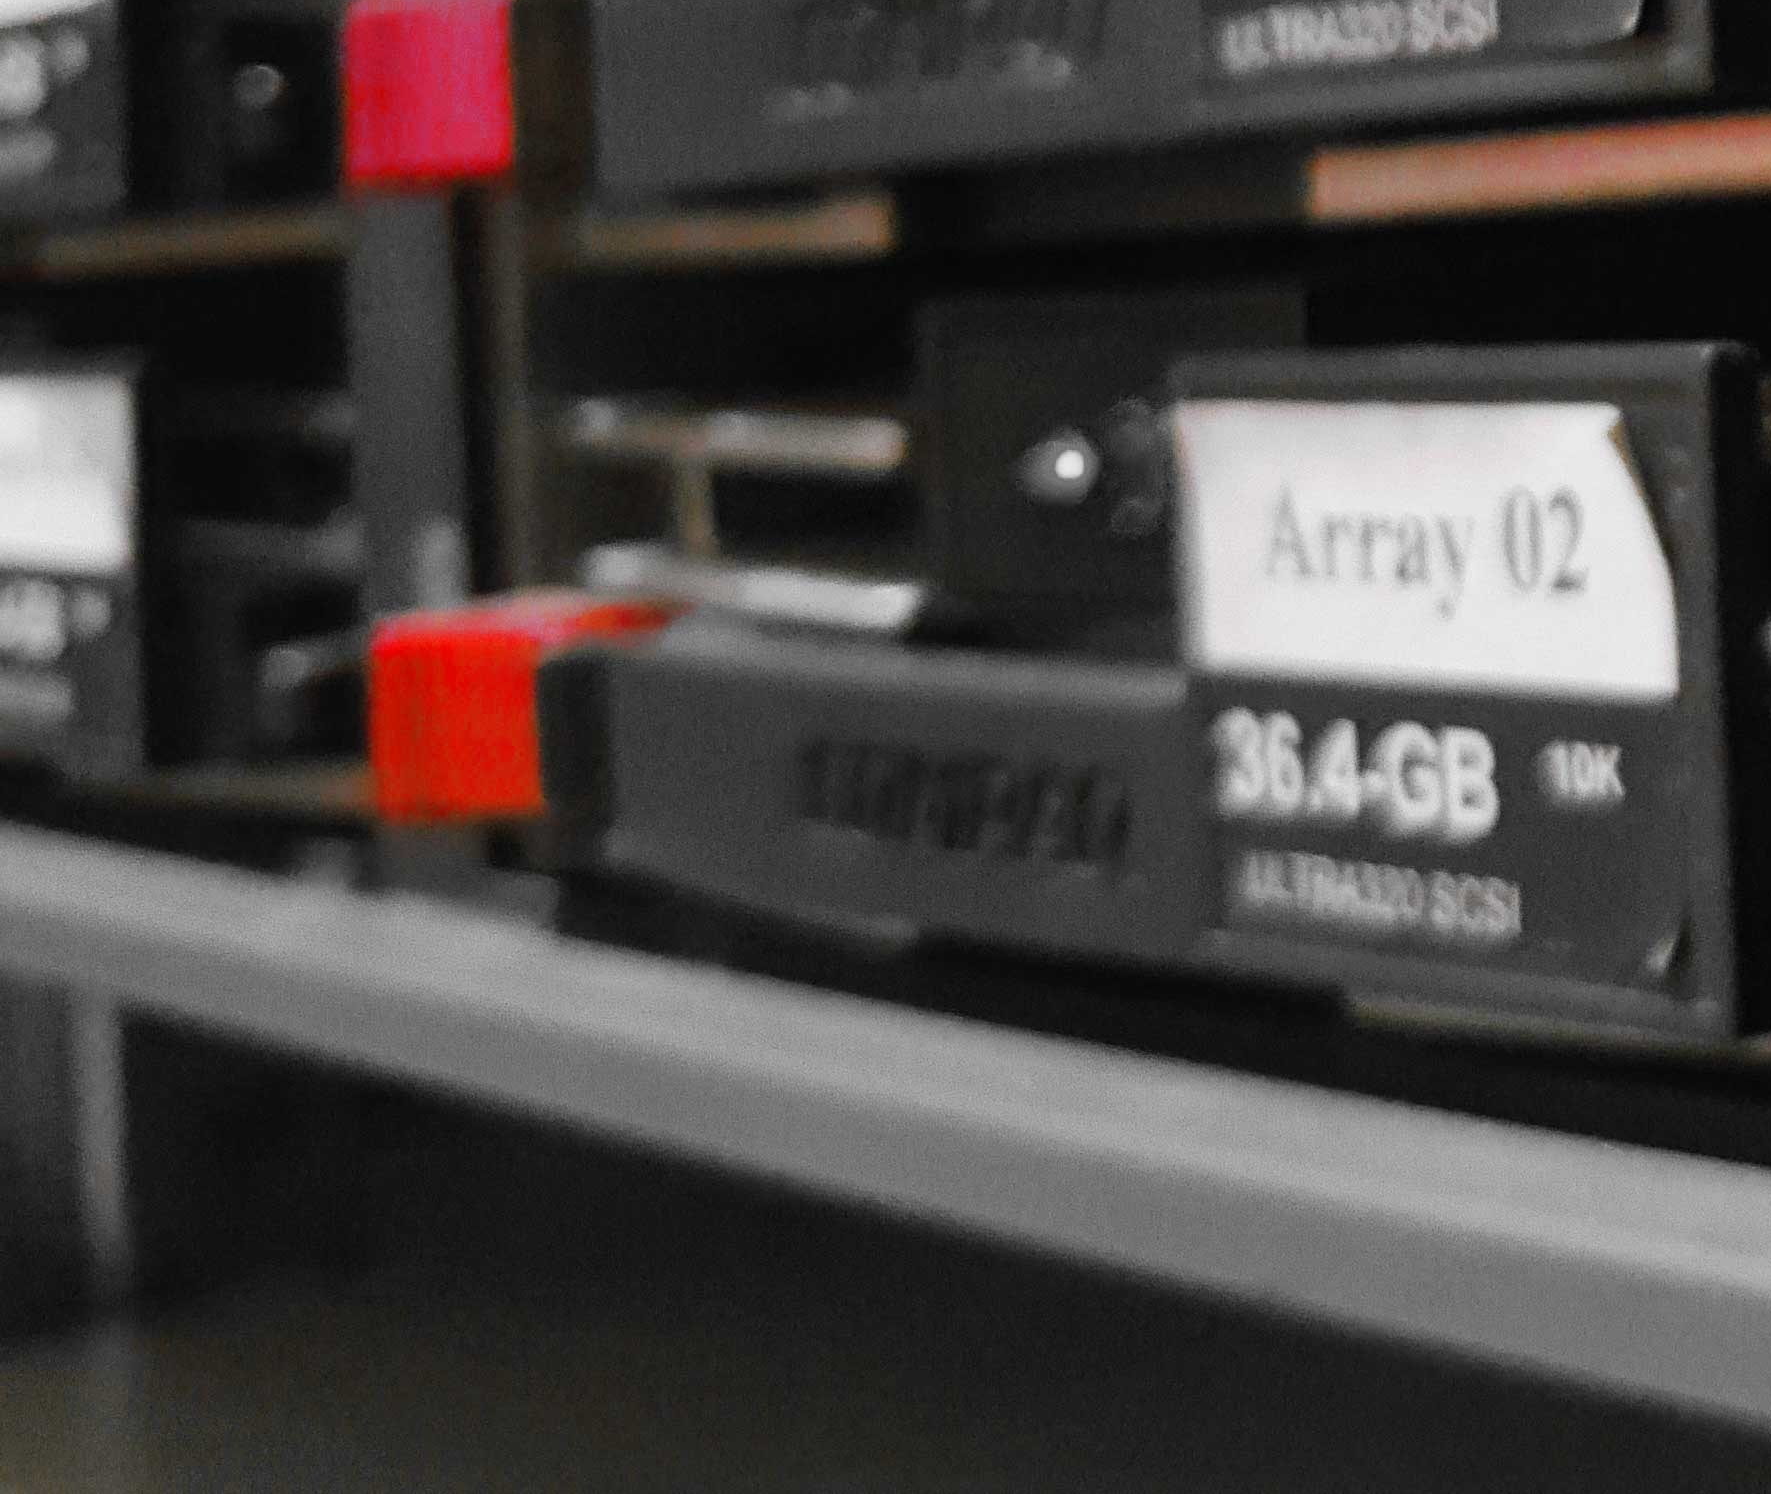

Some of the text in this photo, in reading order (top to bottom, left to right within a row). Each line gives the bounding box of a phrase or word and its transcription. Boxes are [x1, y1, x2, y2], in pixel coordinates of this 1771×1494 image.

[1265, 484, 1592, 618] Array 02
[1210, 706, 1500, 843] 36.4-GB
[1538, 739, 1625, 809] 10K
[1428, 868, 1522, 942] SCSI
